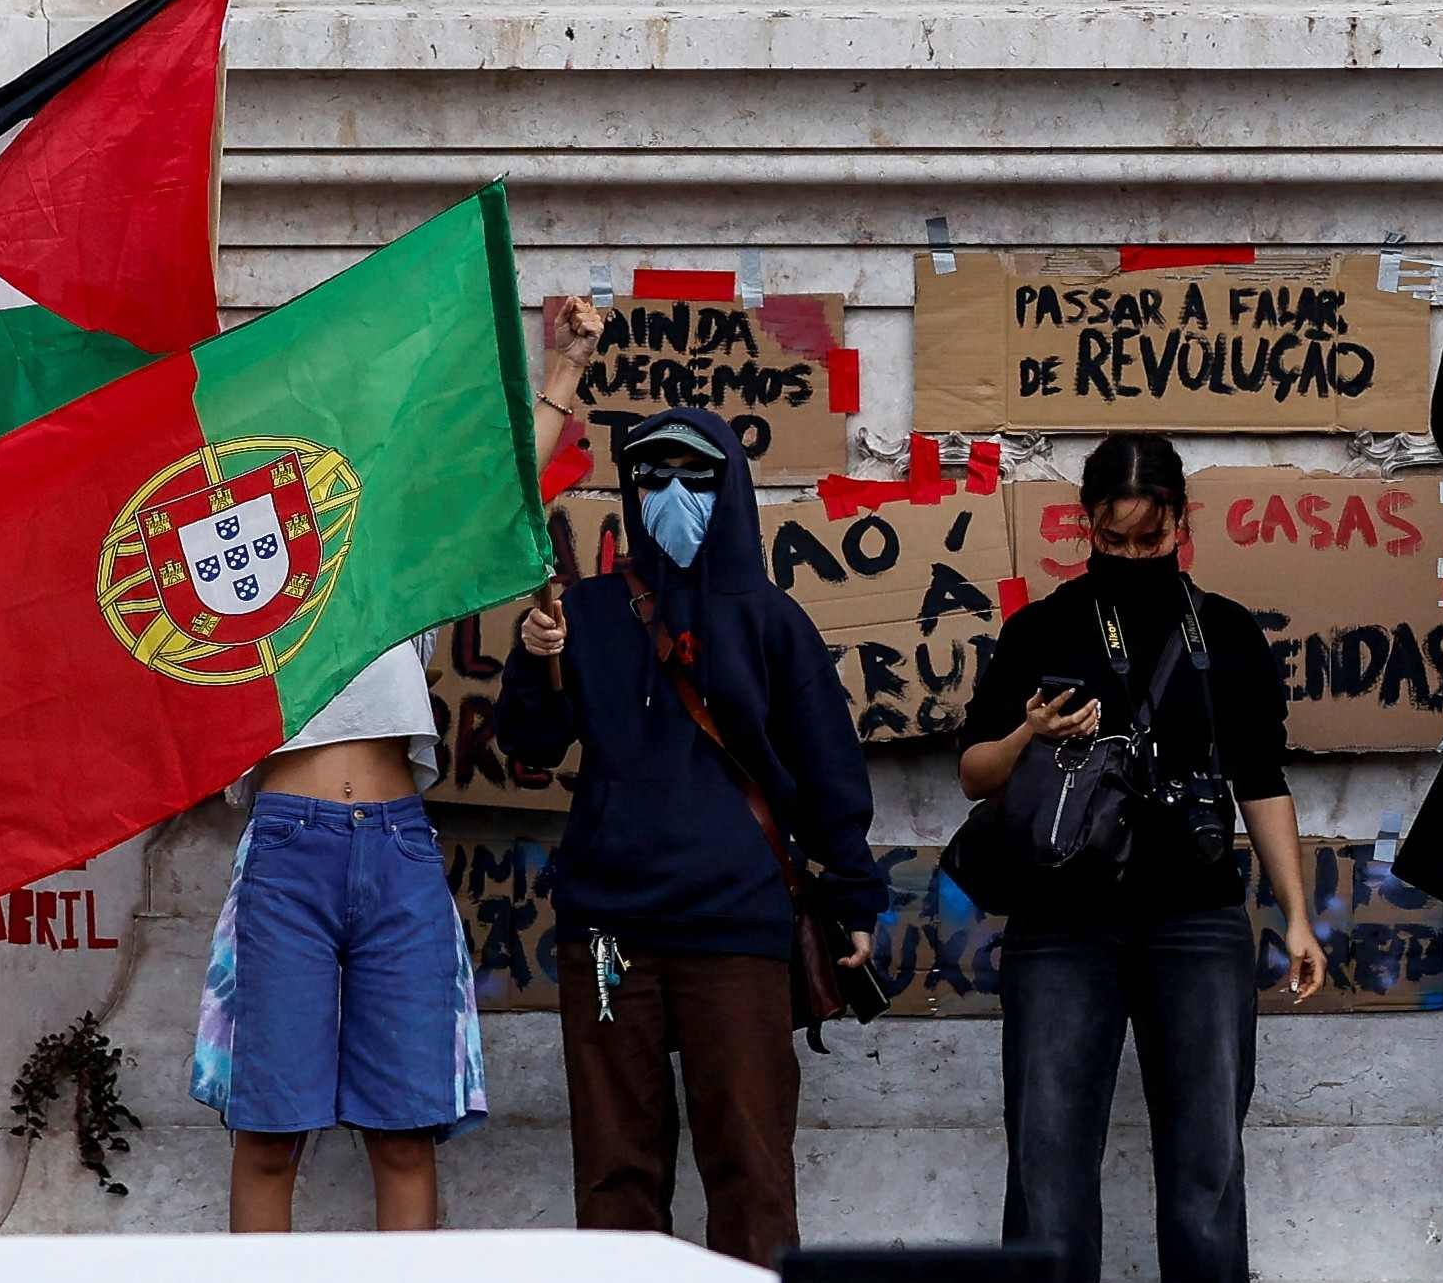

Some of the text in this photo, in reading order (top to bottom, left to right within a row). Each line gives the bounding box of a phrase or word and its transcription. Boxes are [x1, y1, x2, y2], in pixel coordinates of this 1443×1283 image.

[596, 301, 760, 358] AINDA
[1014, 283, 1167, 330] PASSAR
[1178, 281, 1209, 332] A
[1019, 326, 1376, 404] DE REVOLUÇÃO
[1225, 488, 1423, 558] CASAS
